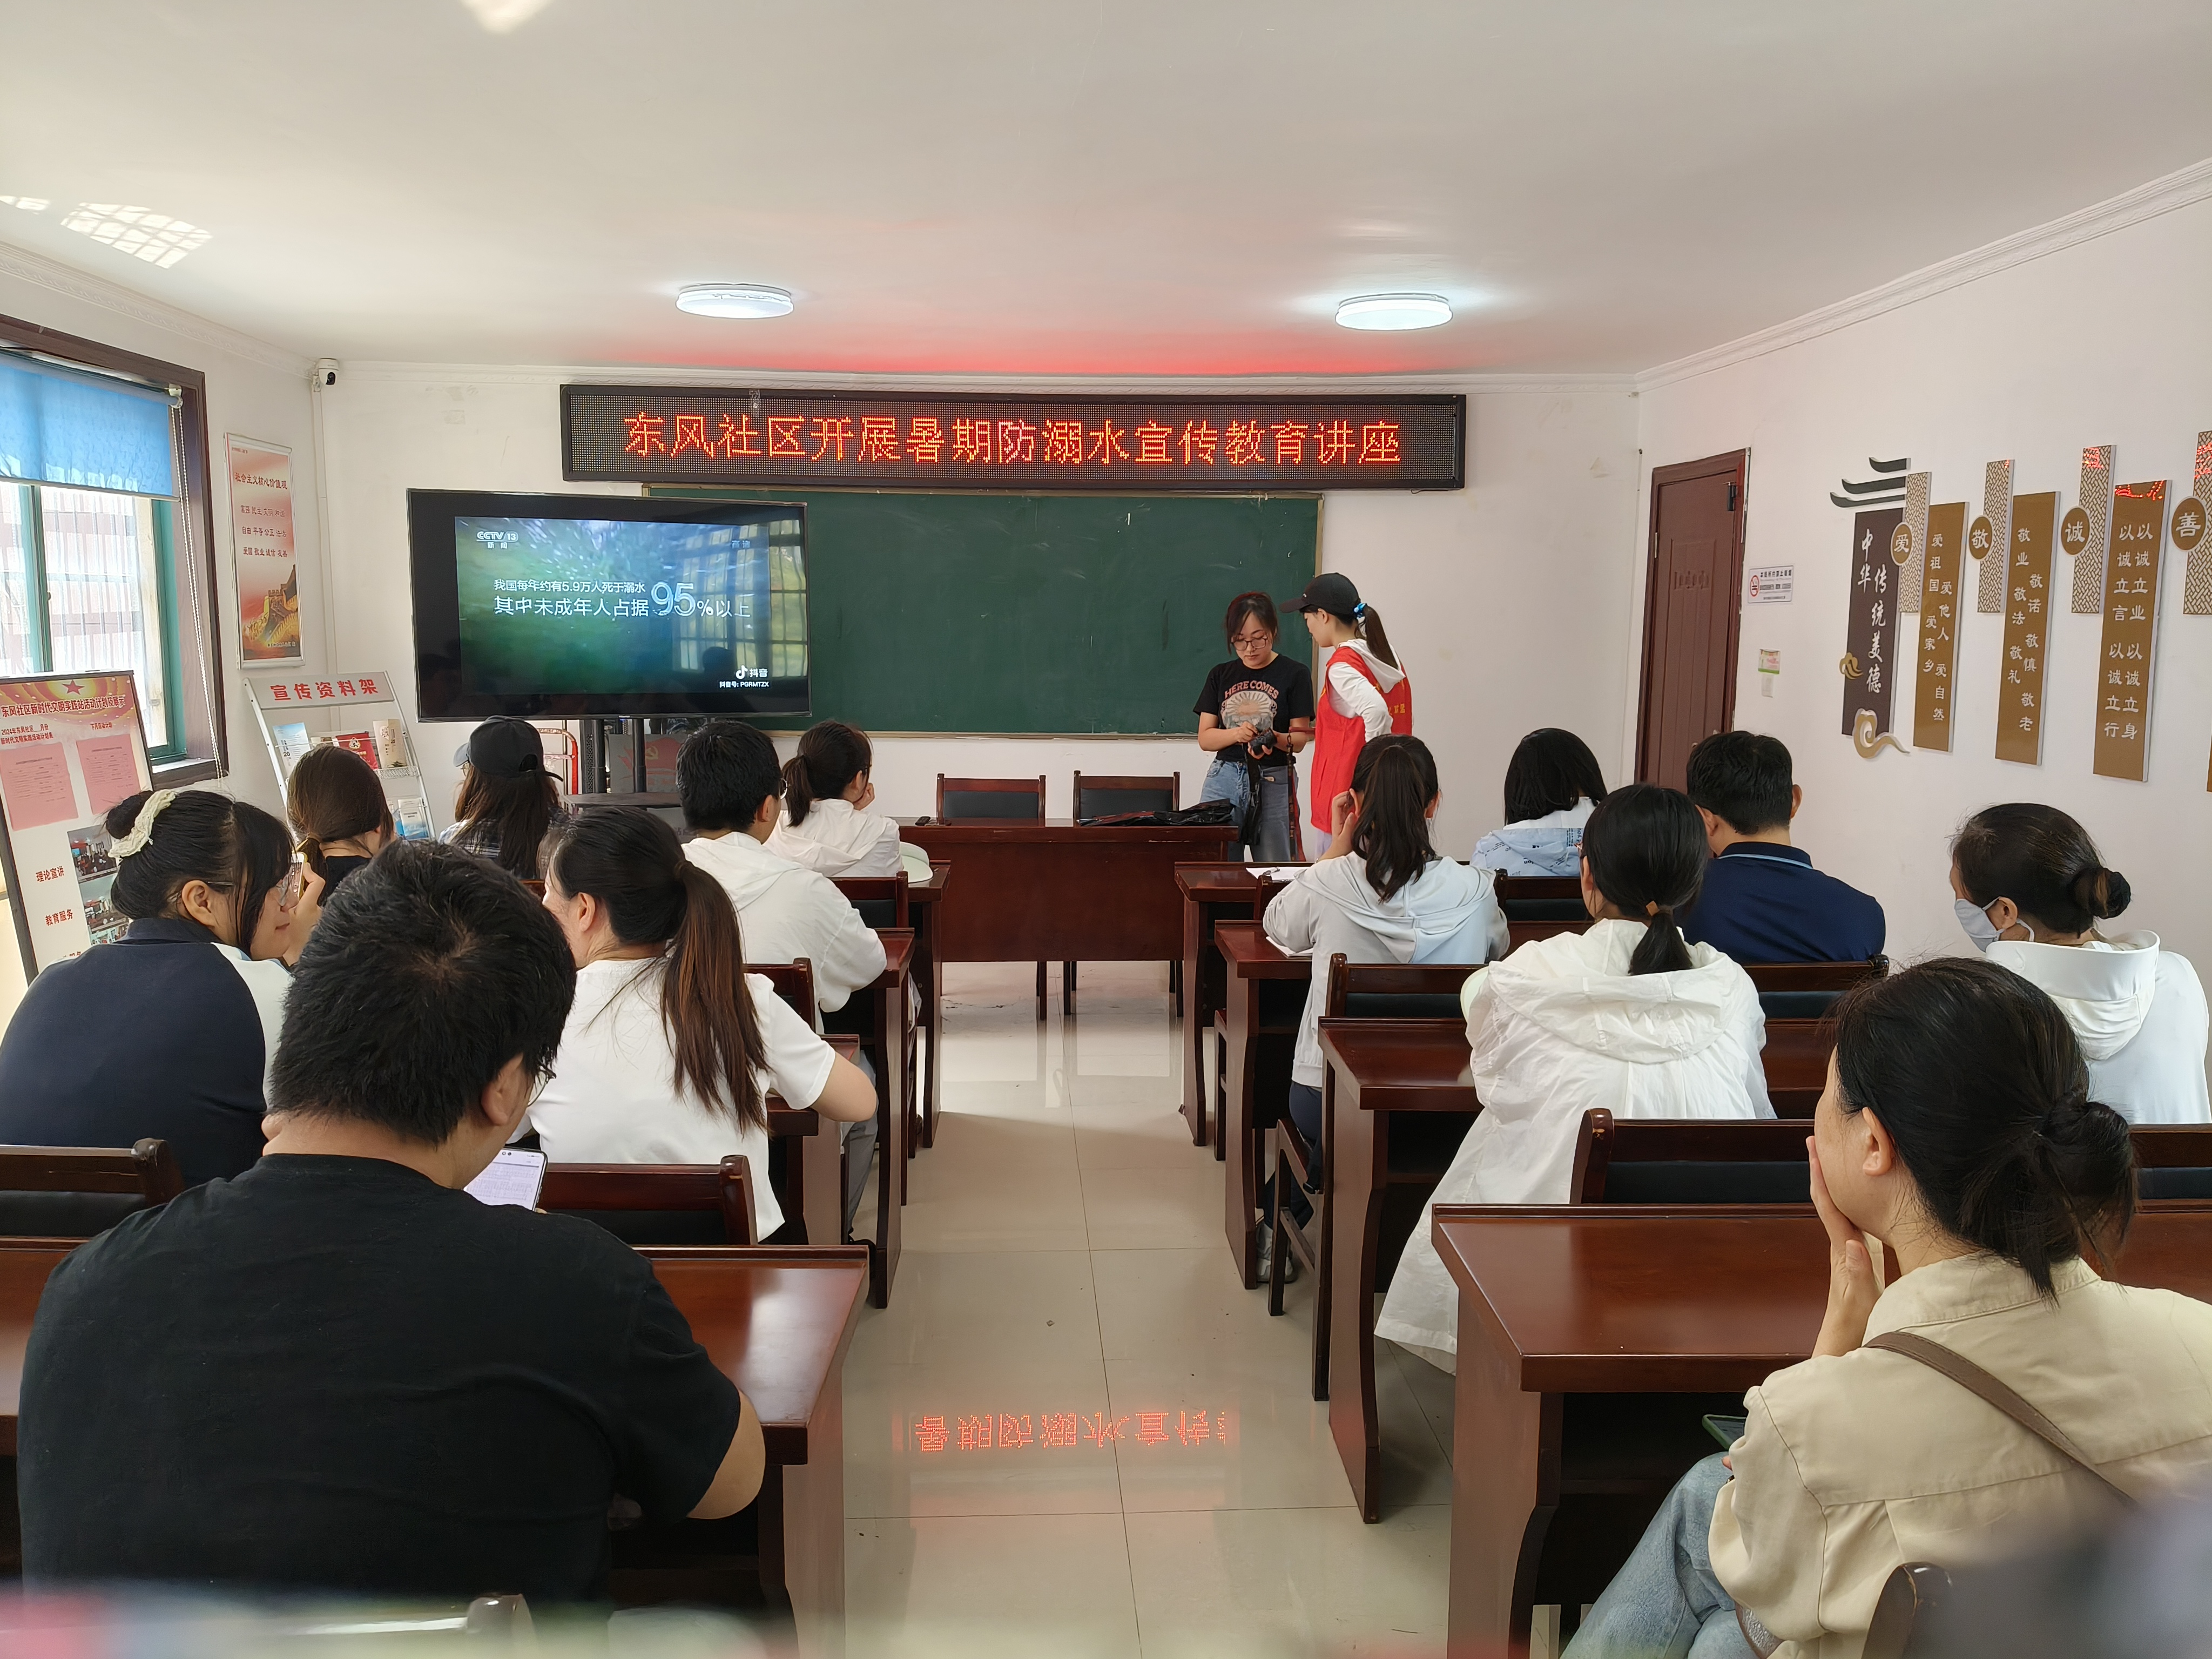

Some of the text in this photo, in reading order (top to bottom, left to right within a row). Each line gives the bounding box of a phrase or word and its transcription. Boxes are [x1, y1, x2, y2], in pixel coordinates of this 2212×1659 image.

[624, 412, 1401, 466] 东风社区开展暑期防溺水宣传教育讲座
[235, 473, 287, 490] 社会主义核心价值观
[477, 531, 504, 539] CCTV
[2065, 521, 2085, 542] 诚
[2176, 512, 2201, 537] 善
[1894, 534, 1910, 553] 爱
[1972, 529, 1989, 549] 敬
[1858, 529, 1873, 593] 中华
[2129, 523, 2153, 621] 以诚立业
[494, 579, 646, 594] 我国每年约有5.9万人死于溺水
[2028, 574, 2043, 613] 敬诺
[1923, 534, 1943, 673] 爱祖国 爱家乡
[2007, 528, 2031, 684] 敬业 敬法 敬礼
[1866, 564, 1887, 693] 传统美德
[2105, 524, 2135, 738] 以诚立言 以诚立行
[1933, 581, 1952, 721] 爱他人 爱自然
[750, 669, 768, 677] 抖音
[271, 679, 377, 700] 宣传资料架
[1225, 680, 1279, 699] HERE COMES
[2122, 643, 2143, 740] 以诚立身
[1, 696, 126, 717] 东风社区新时代文明实践站活动计划及展示
[2019, 692, 2034, 731] 敬老
[36, 866, 64, 882] 理论宣讲
[45, 909, 73, 926] 教育服务
